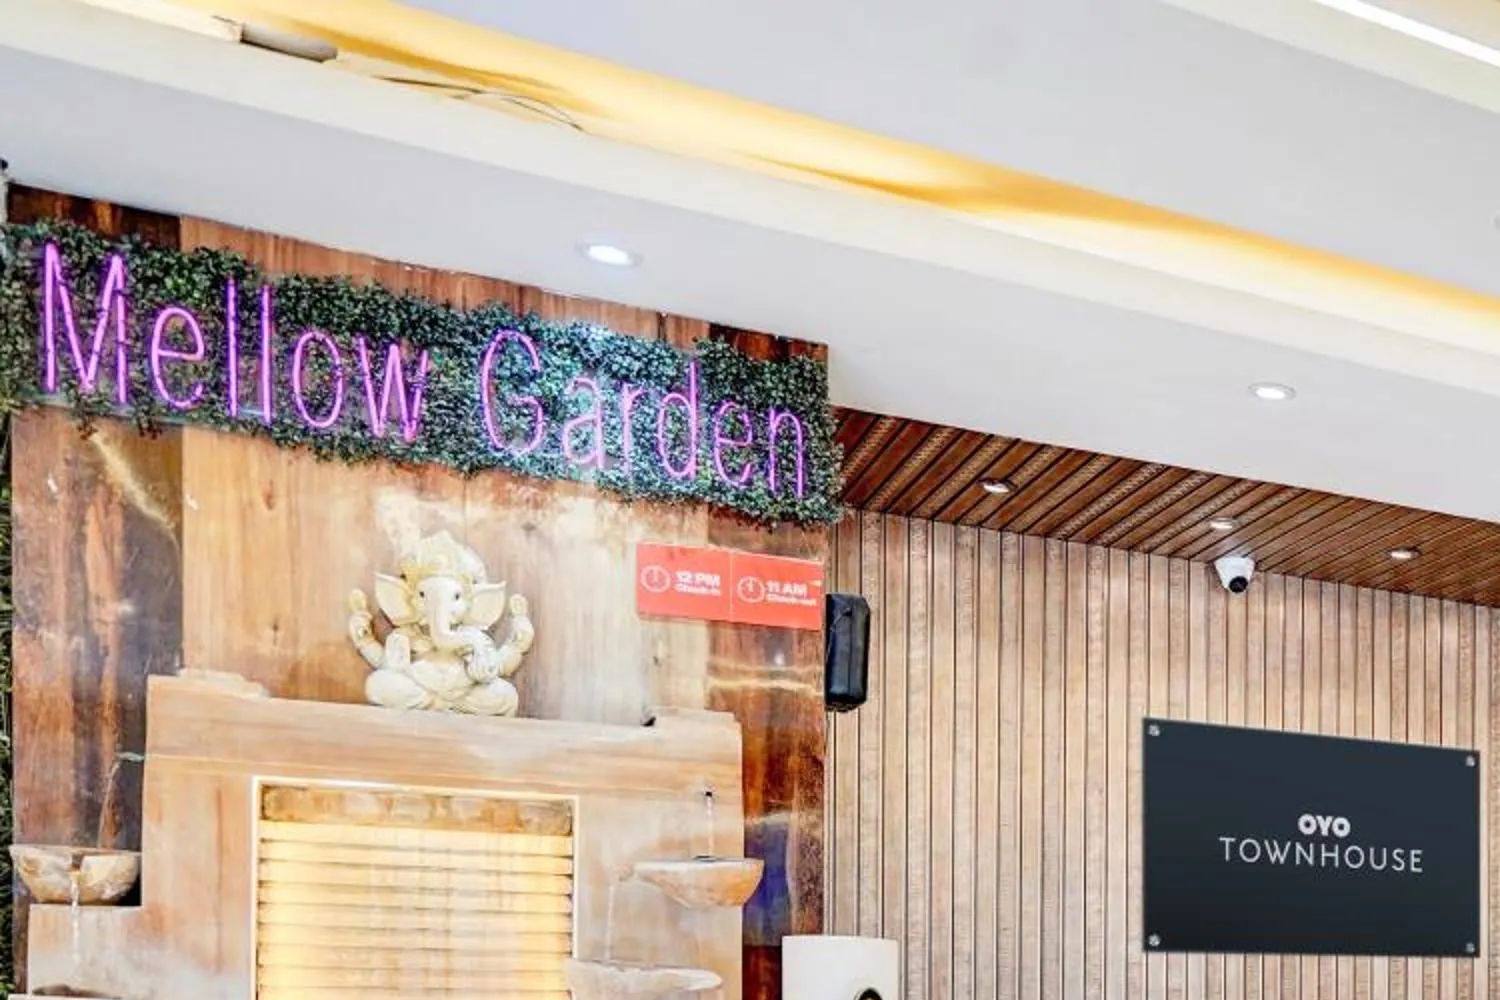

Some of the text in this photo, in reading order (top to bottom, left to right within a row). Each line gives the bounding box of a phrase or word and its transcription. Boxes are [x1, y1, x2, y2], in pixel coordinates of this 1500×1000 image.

[44, 241, 806, 498] Mellow Garden
[695, 573, 720, 587] PM
[782, 582, 808, 598] AM
[1297, 813, 1351, 837] OYO
[1219, 836, 1424, 873] TOWNHOUSE
